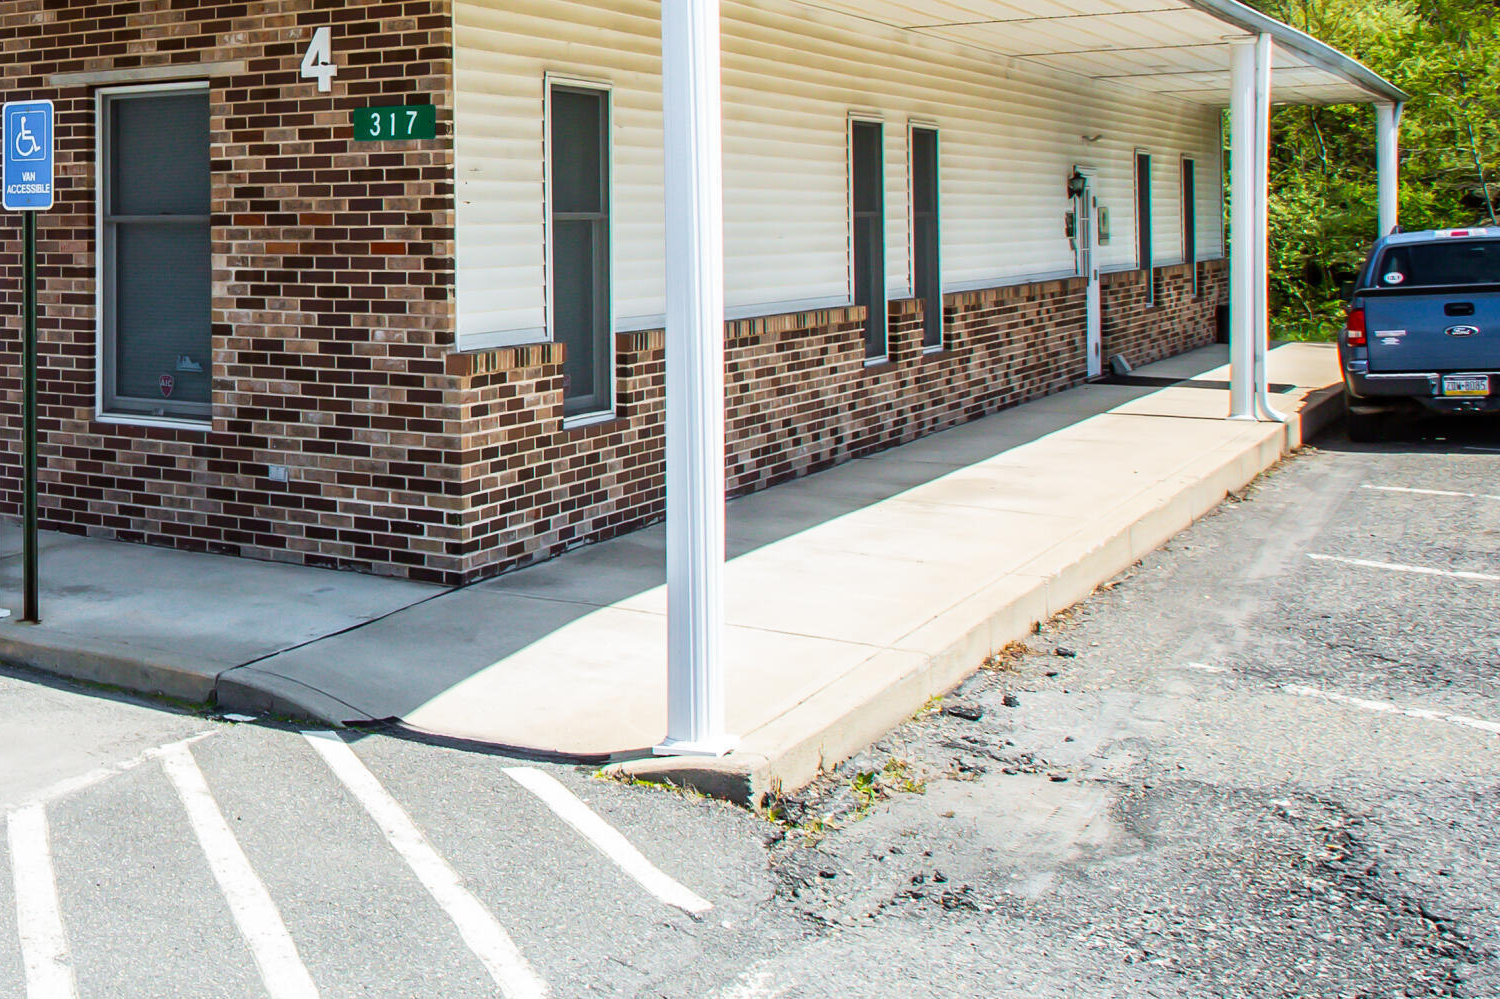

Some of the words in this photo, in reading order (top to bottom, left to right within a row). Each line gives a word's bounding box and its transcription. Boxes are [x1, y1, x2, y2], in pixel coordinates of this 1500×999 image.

[301, 27, 338, 92] 4
[369, 111, 418, 136] 317
[21, 171, 36, 182] VAN
[7, 183, 50, 194] ACCESSIBLE
